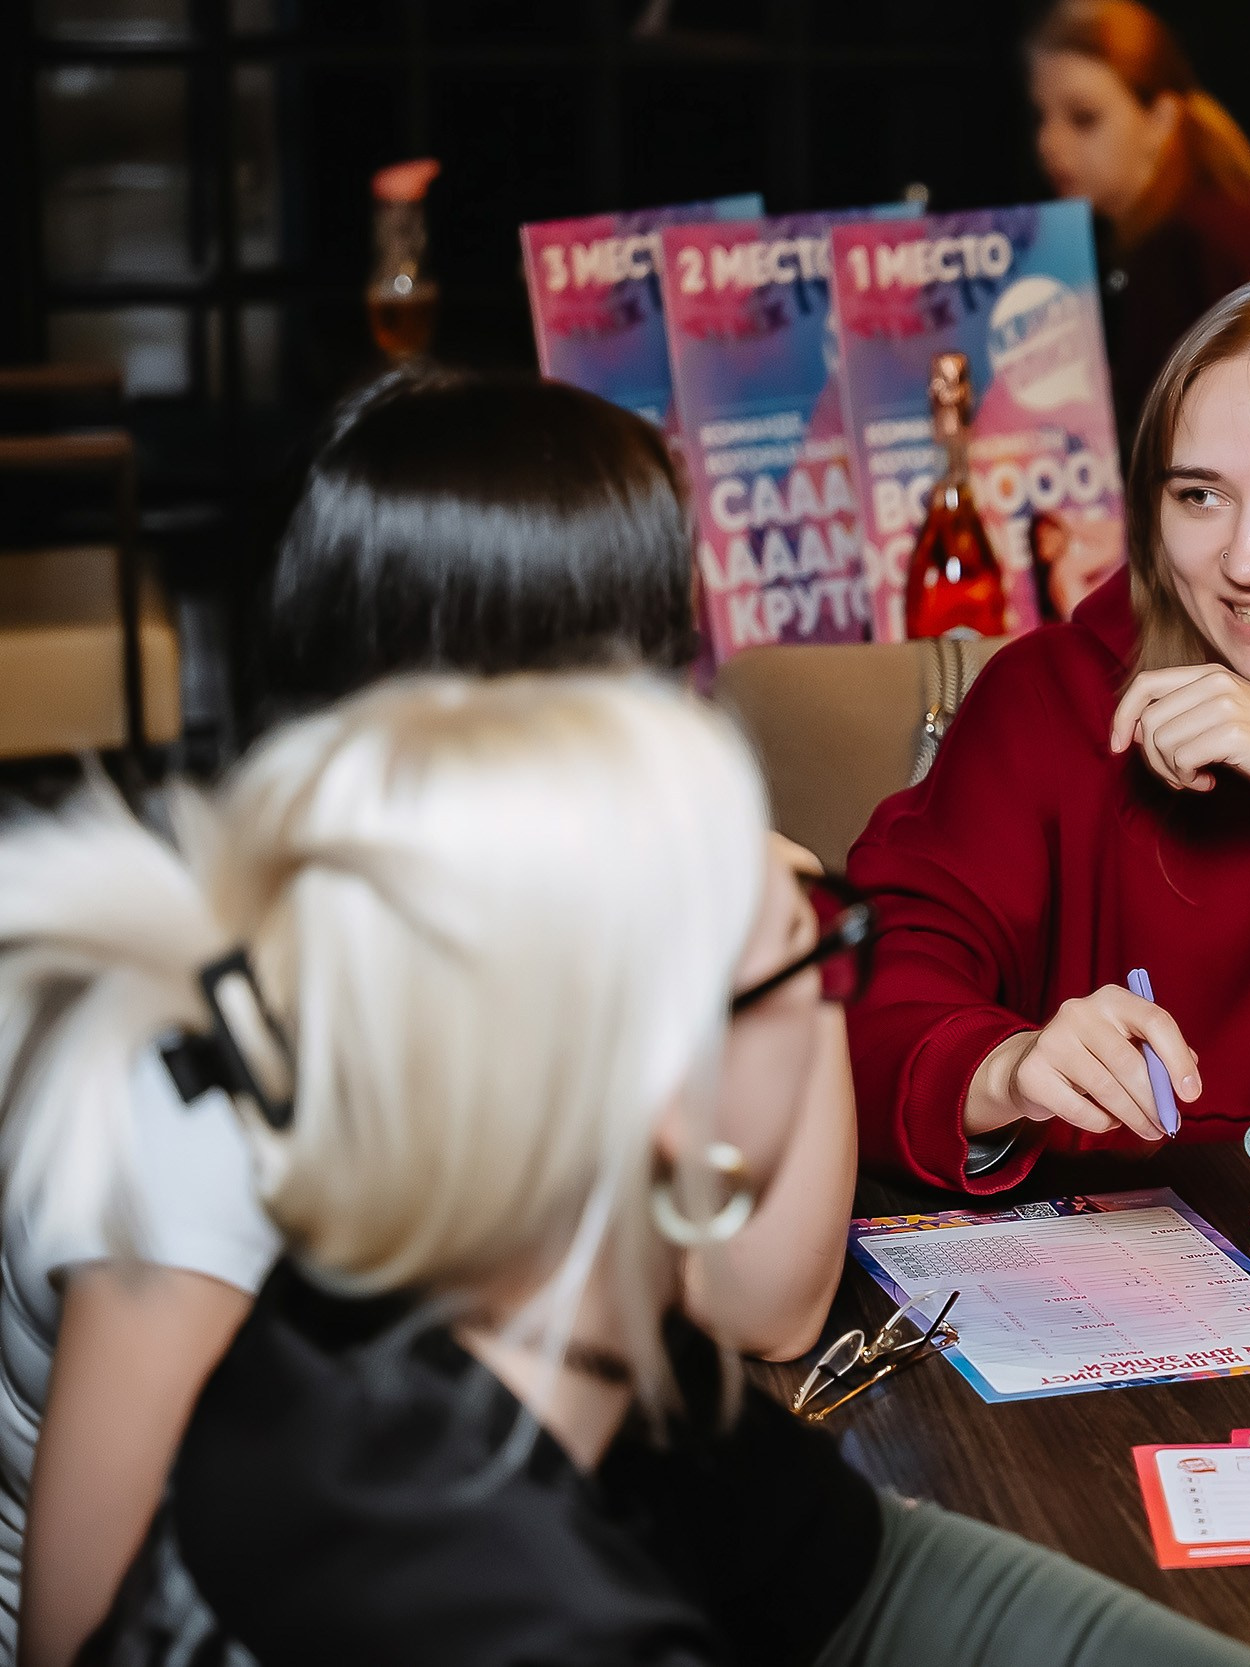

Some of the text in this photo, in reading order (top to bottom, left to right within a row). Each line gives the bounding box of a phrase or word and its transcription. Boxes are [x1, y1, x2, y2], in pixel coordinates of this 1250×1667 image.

[541, 244, 569, 293] 3
[676, 246, 706, 294] 2
[847, 231, 1013, 292] 1 МЕСТО
[1216, 1277, 1249, 1285] РАУНД
[1041, 1354, 1244, 1385] НЕ ПРОСТО ЛИСТ
[1185, 1347, 1236, 1358] ДЛЯ
